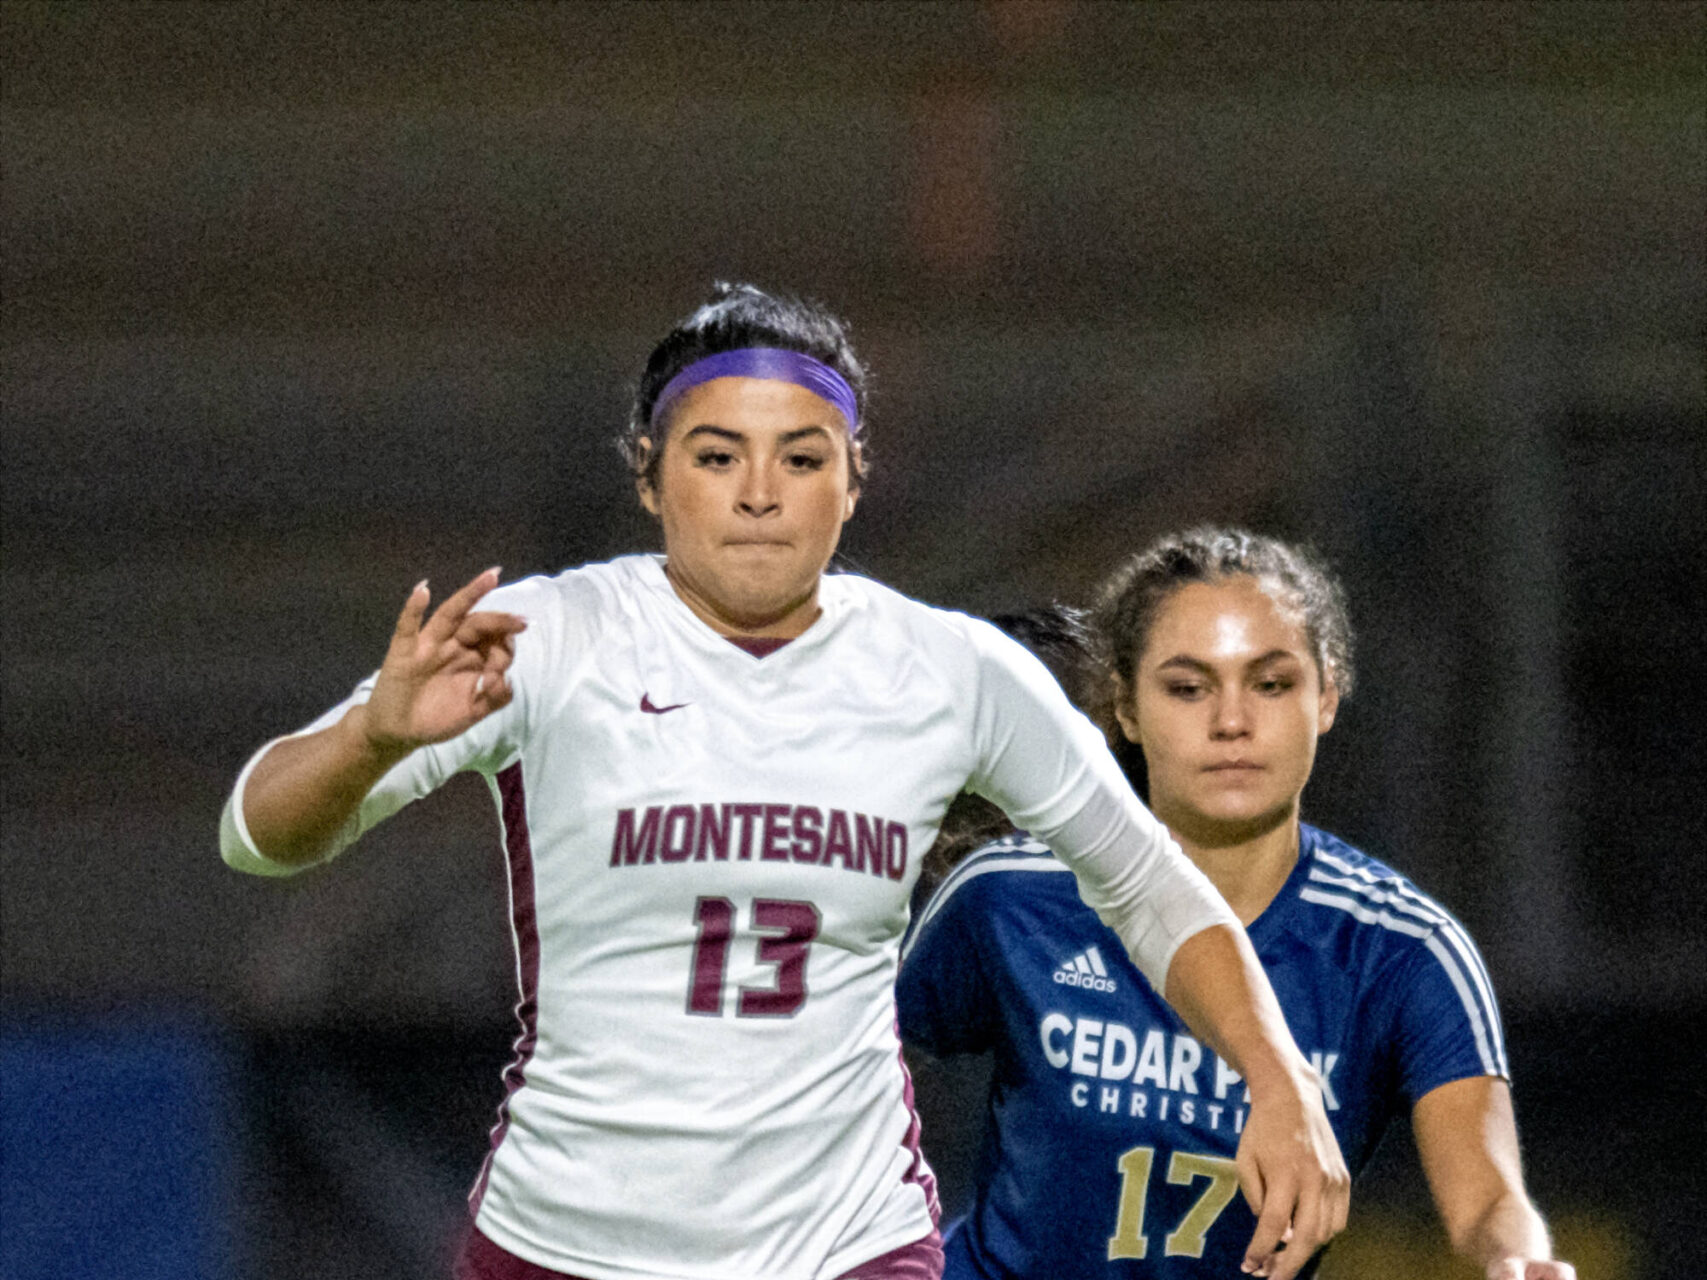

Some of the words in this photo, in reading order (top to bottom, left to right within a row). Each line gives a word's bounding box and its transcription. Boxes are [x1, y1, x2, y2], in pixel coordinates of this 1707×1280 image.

[609, 803, 909, 884] MONTESANO
[685, 895, 823, 1019] 13
[1053, 970, 1117, 993] adidas
[1041, 1013, 1202, 1095] CEDAR
[1215, 1052, 1340, 1111] PK
[1071, 1083, 1244, 1134] CHRISTI
[1107, 1147, 1241, 1261] 17
